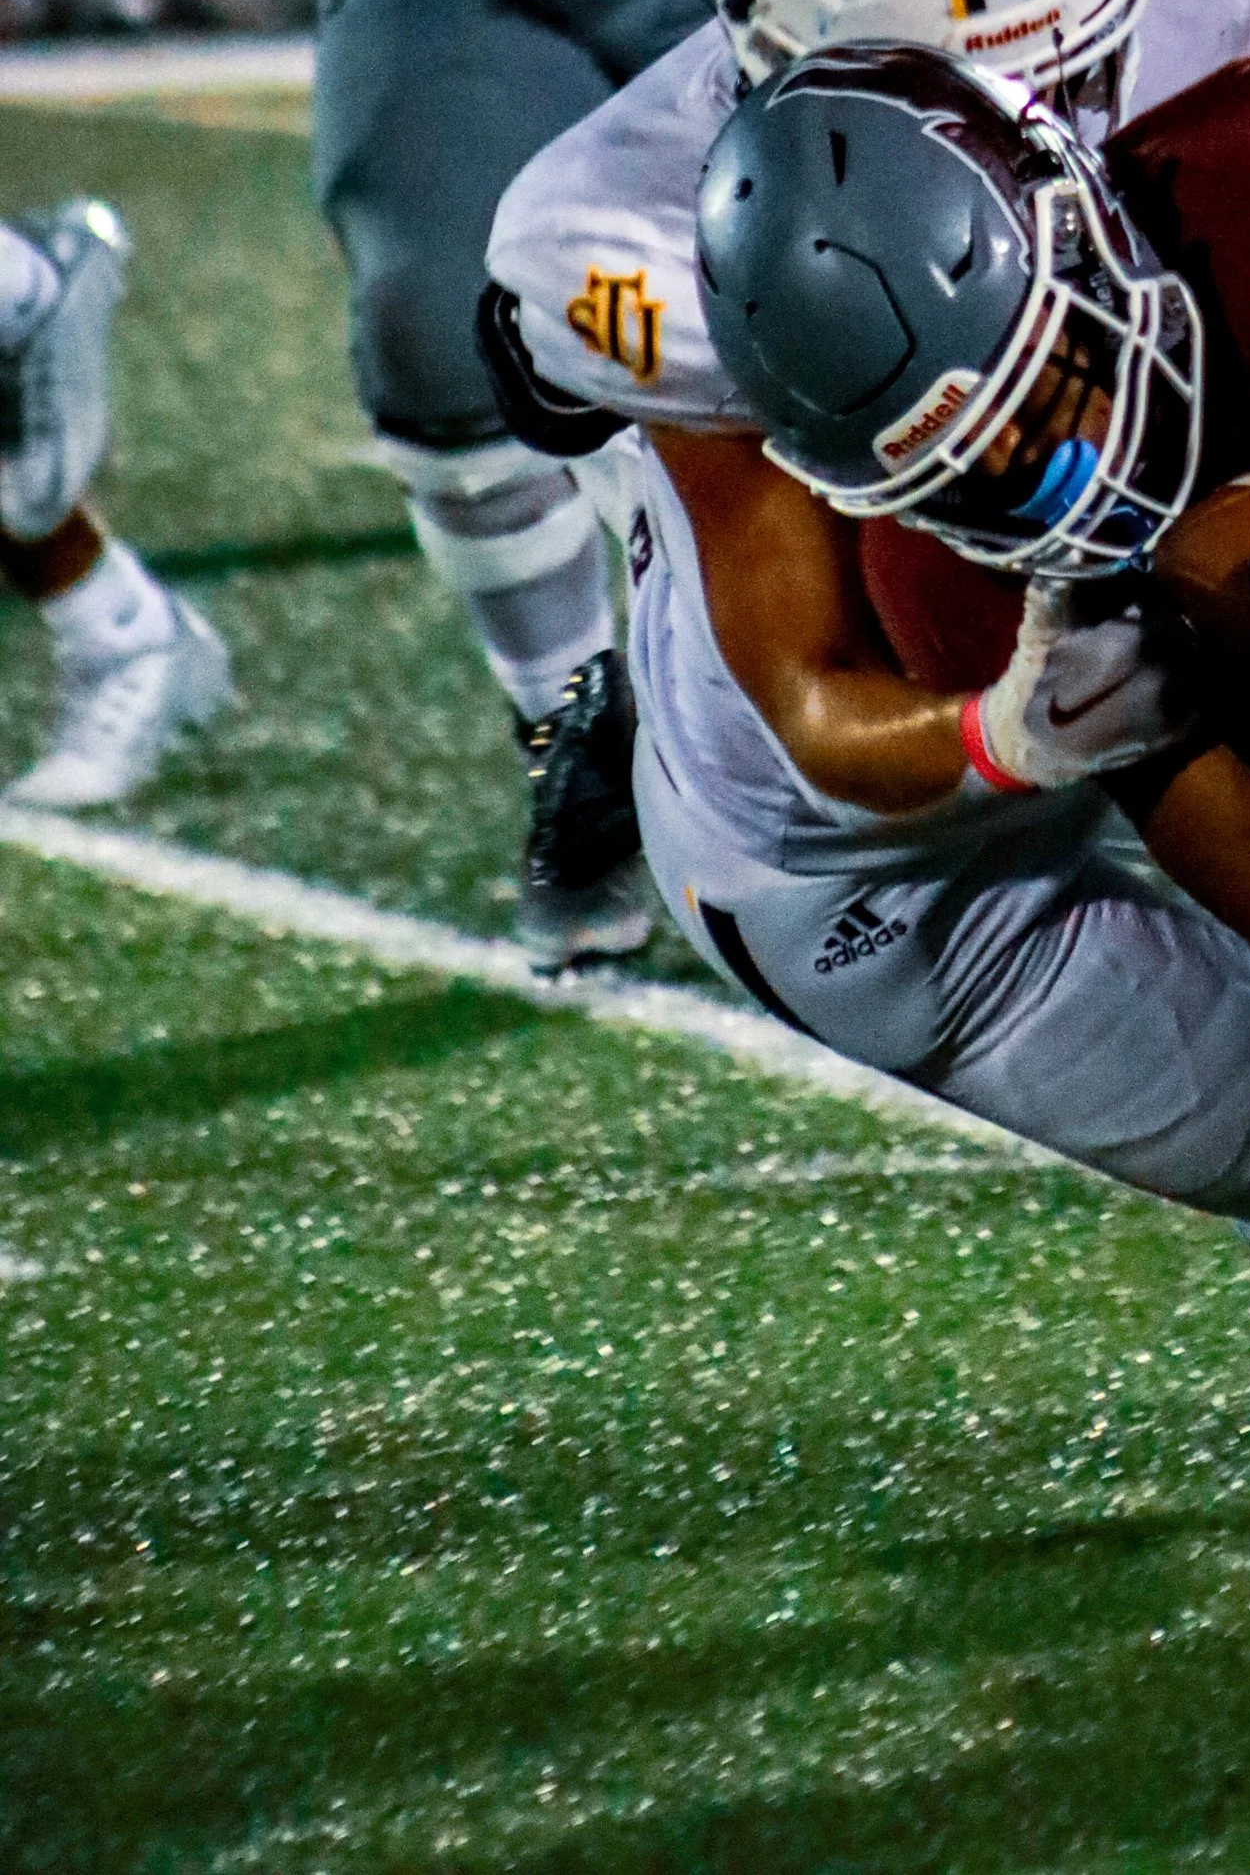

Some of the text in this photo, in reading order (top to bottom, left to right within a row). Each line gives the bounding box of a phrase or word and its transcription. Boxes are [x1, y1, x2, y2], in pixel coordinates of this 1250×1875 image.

[965, 9, 1062, 53] Riddell
[882, 382, 970, 466] Riddell
[813, 917, 909, 975] adidas
